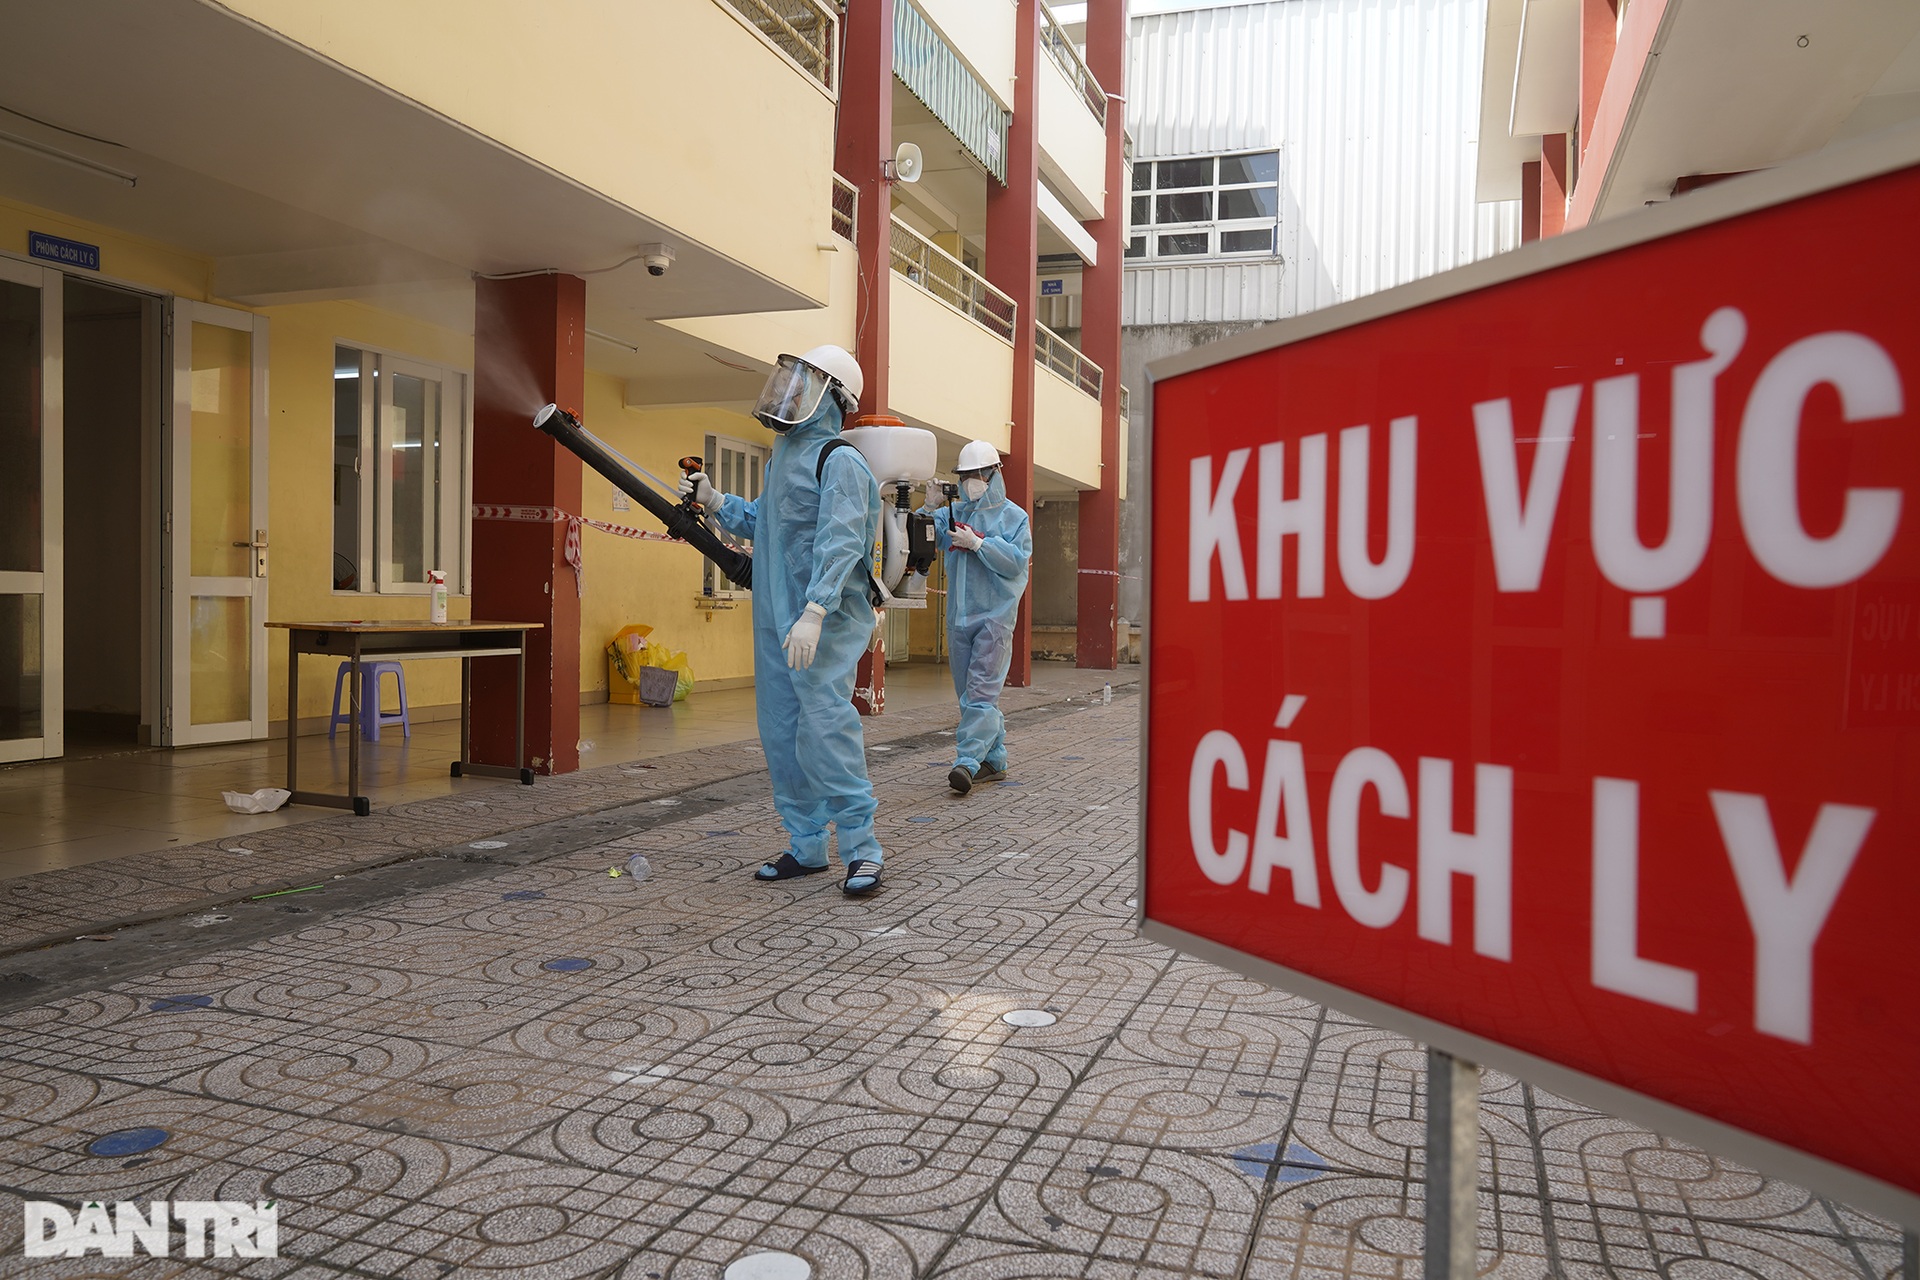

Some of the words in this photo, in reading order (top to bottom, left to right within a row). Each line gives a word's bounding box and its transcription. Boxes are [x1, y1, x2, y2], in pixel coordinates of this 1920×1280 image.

[35, 240, 59, 257] PHÒNG
[60, 244, 78, 261] CÁCH
[79, 250, 88, 263] LY
[89, 253, 94, 265] 6
[1188, 415, 1417, 602] KHU
[1472, 306, 1904, 639] VỰC
[1188, 694, 1513, 963] CÁCH
[1591, 776, 1878, 1045] LY
